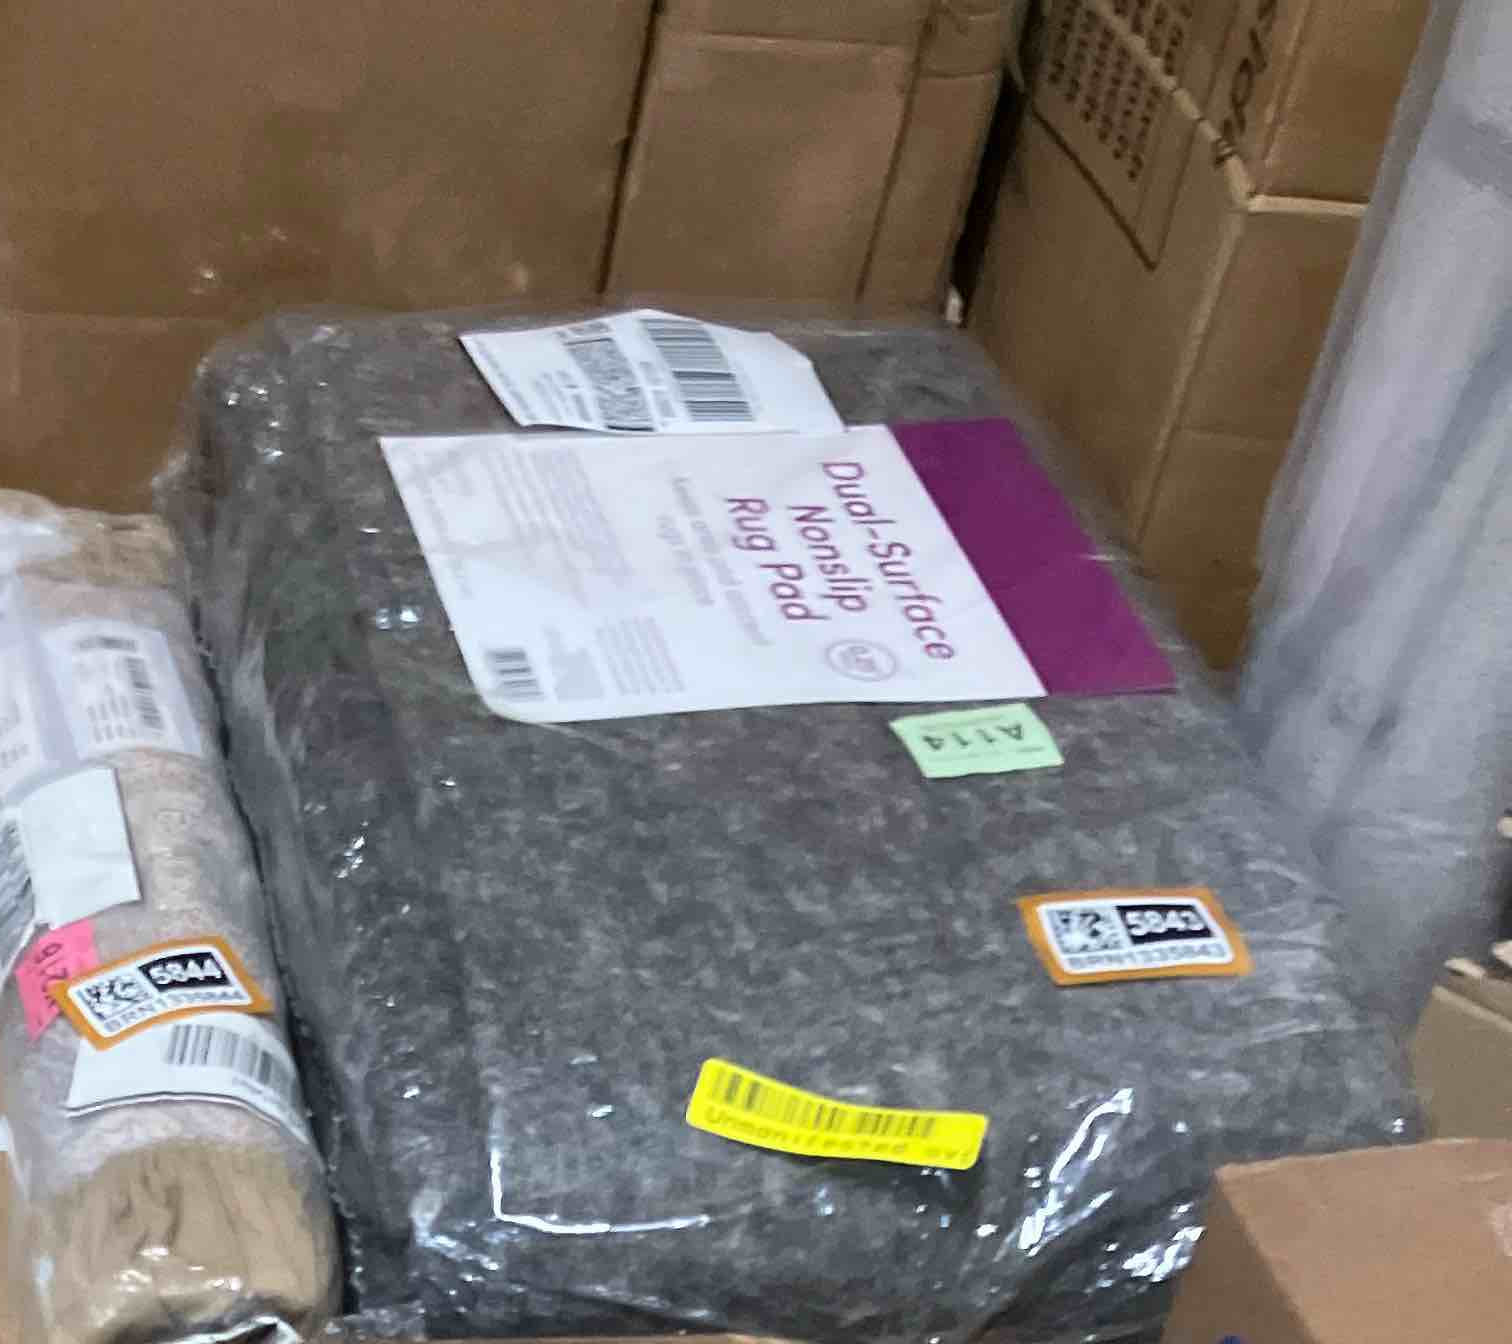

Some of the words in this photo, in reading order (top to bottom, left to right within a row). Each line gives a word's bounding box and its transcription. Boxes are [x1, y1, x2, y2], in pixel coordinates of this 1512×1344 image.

[728, 497, 778, 553] Rug
[759, 562, 831, 622] Pad
[788, 504, 875, 614] Nonslip
[821, 461, 955, 661] Dual-Surface
